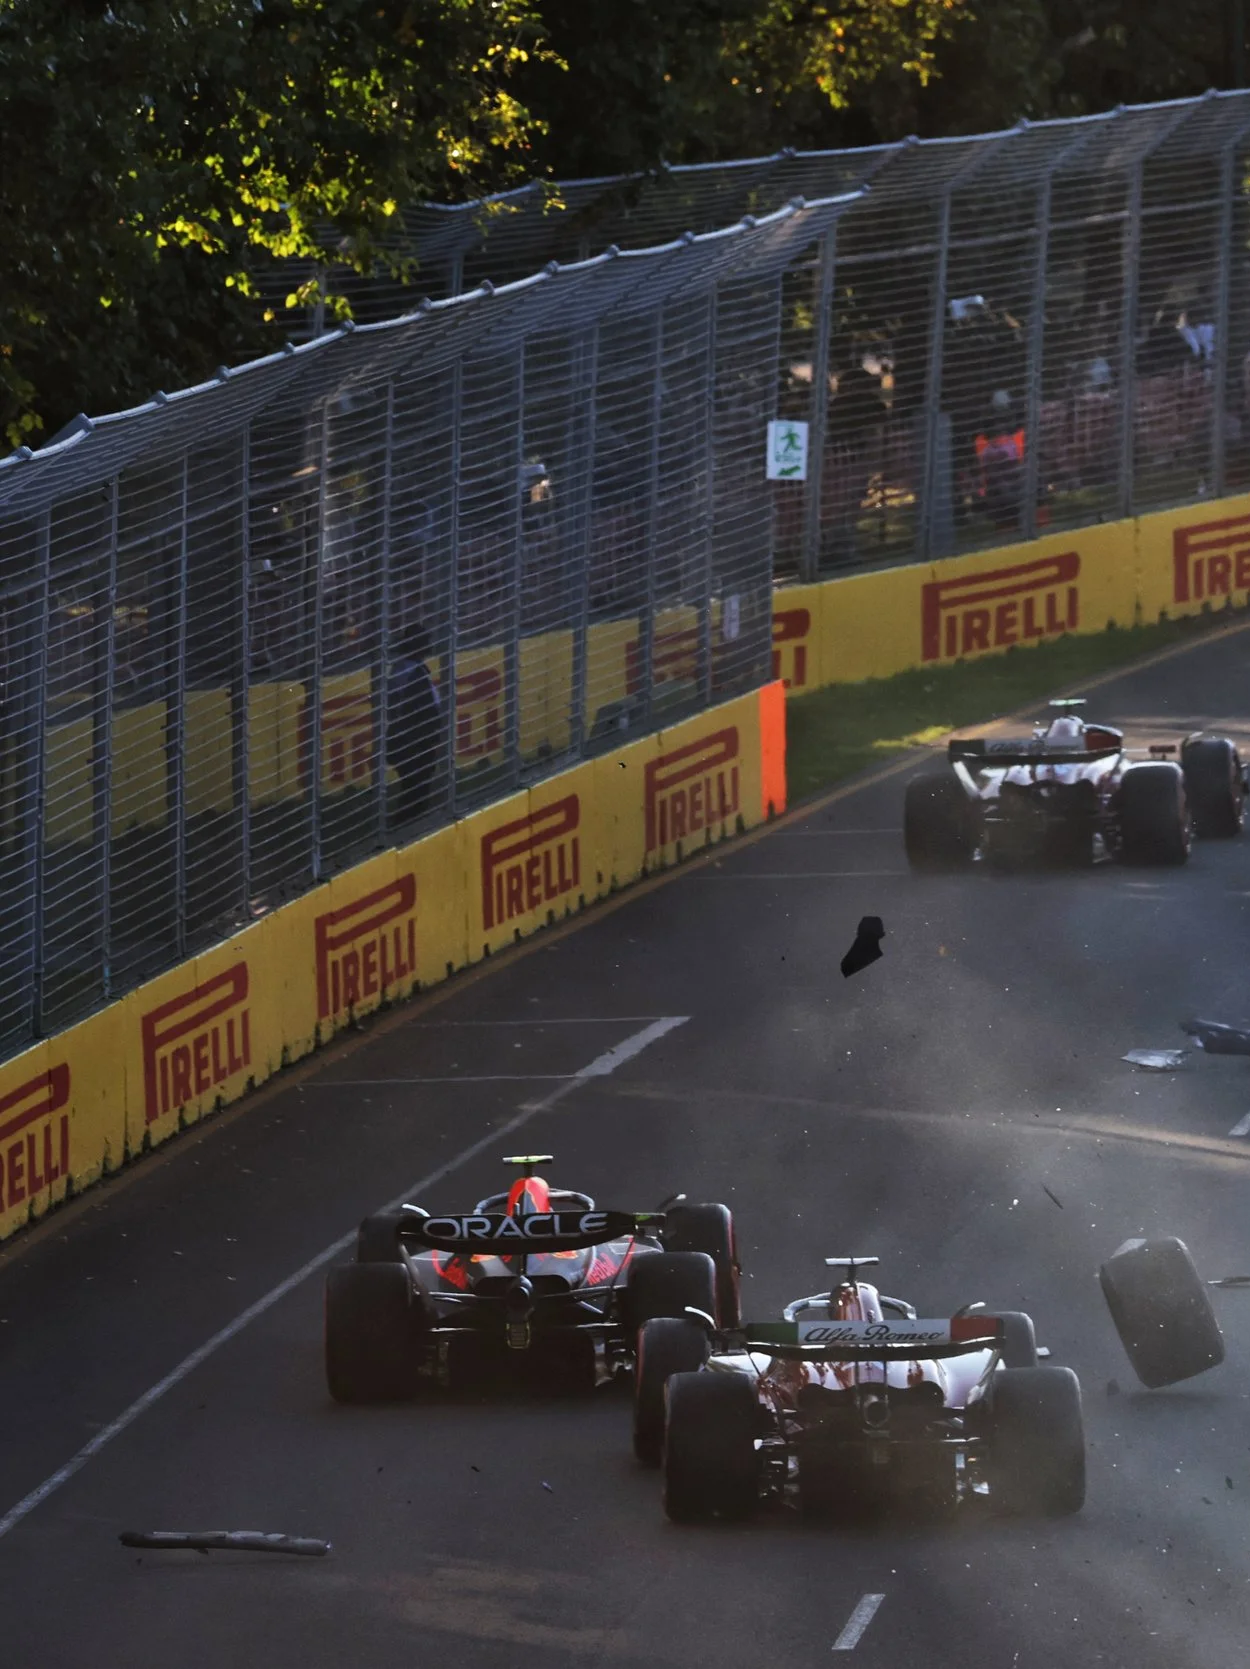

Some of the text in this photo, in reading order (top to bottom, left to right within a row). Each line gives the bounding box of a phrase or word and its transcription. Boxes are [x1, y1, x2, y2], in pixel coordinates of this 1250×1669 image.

[921, 551, 1080, 661] PIRELLI
[644, 726, 739, 852] PIRELLI
[481, 793, 580, 931] PIRELLI
[315, 872, 417, 1020] PIRELLI
[141, 961, 250, 1125] PIRELLI
[423, 1213, 609, 1239] ORACLE
[804, 1324, 944, 1344] Alfa Romeo
